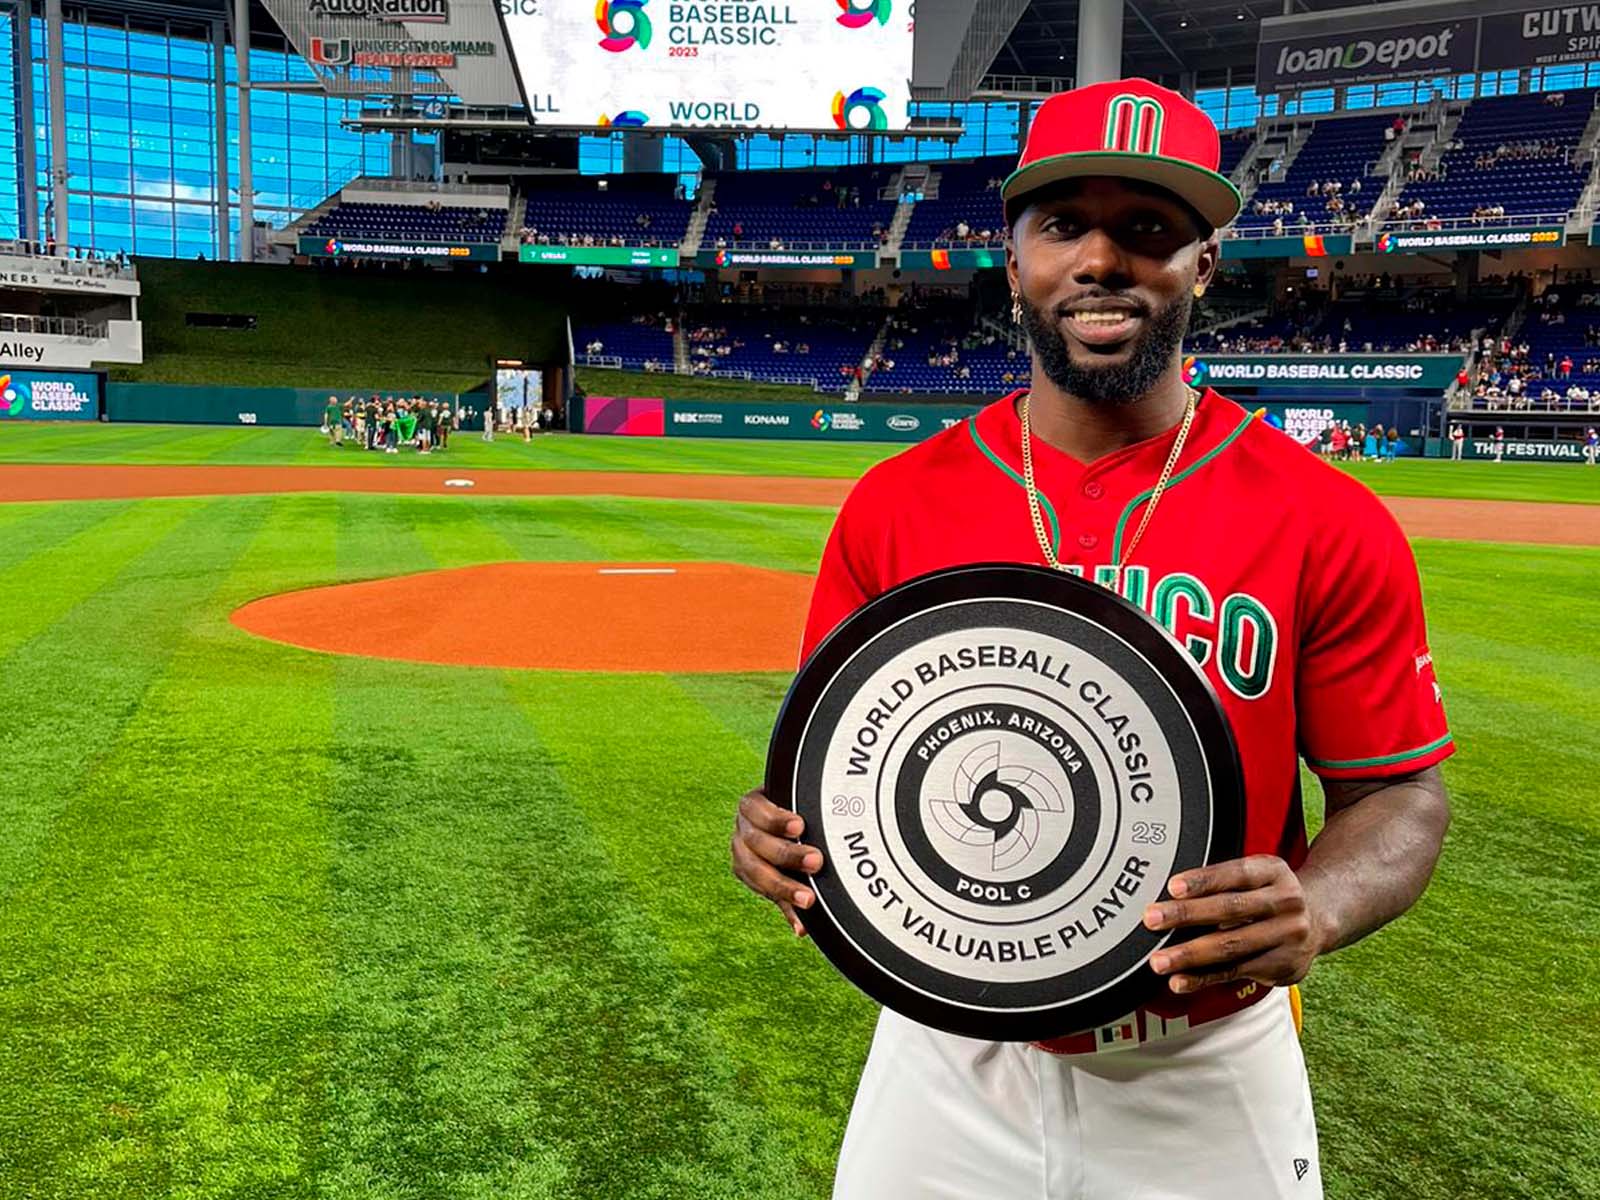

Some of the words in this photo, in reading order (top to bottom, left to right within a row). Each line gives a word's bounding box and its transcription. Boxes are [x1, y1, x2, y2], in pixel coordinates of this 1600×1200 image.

[669, 5, 798, 24] BASEBALL
[669, 26, 777, 45] CLASSIC
[354, 40, 429, 53] UNIVERSITY
[431, 41, 450, 53] OF
[451, 41, 496, 55] MIAMI
[669, 47, 699, 57] 2023
[1276, 28, 1454, 75] loanDepot
[354, 53, 402, 67] HEALTH
[404, 54, 454, 67] SYSTEM
[425, 103, 442, 116] 42
[669, 101, 760, 121] WORLD
[1398, 237, 1434, 247] WORLD
[1434, 235, 1485, 246] BASEBALL
[1486, 233, 1531, 244] CLASSIC
[1531, 232, 1559, 242] 2023
[342, 243, 372, 252] WORLD
[373, 244, 415, 254] BASEBALL
[415, 246, 449, 255] CLASSIC
[450, 247, 470, 256] 2023
[732, 254, 760, 263] WORLD
[761, 254, 800, 264] BASEBALL
[801, 255, 834, 264] CLASSIC
[834, 255, 855, 265] 2023
[0, 342, 44, 362] Alley
[1209, 364, 1265, 378] WORLD
[1267, 364, 1349, 378] BASEBALL
[1351, 364, 1423, 379] CLASSIC
[31, 381, 74, 391] WORLD
[31, 391, 90, 402] BASEBALL
[31, 402, 81, 411] CLASSIC
[1284, 408, 1334, 419] WORLD
[744, 414, 790, 426] KONAMI
[1506, 443, 1580, 457] FESTIVAL
[847, 678, 914, 777] WORLD
[914, 645, 1072, 688] BASEBALL
[1079, 680, 1155, 804] CLASSIC
[917, 709, 1001, 760] PHOENIX,
[1007, 713, 1083, 774] ARIZONA
[831, 794, 866, 817] 20
[1131, 822, 1167, 845] 23
[844, 830, 903, 911] MOST
[901, 907, 1057, 963] VALUABLE
[1058, 855, 1150, 950] PLAYER
[955, 878, 1012, 900] POOL
[1017, 885, 1032, 899] C
